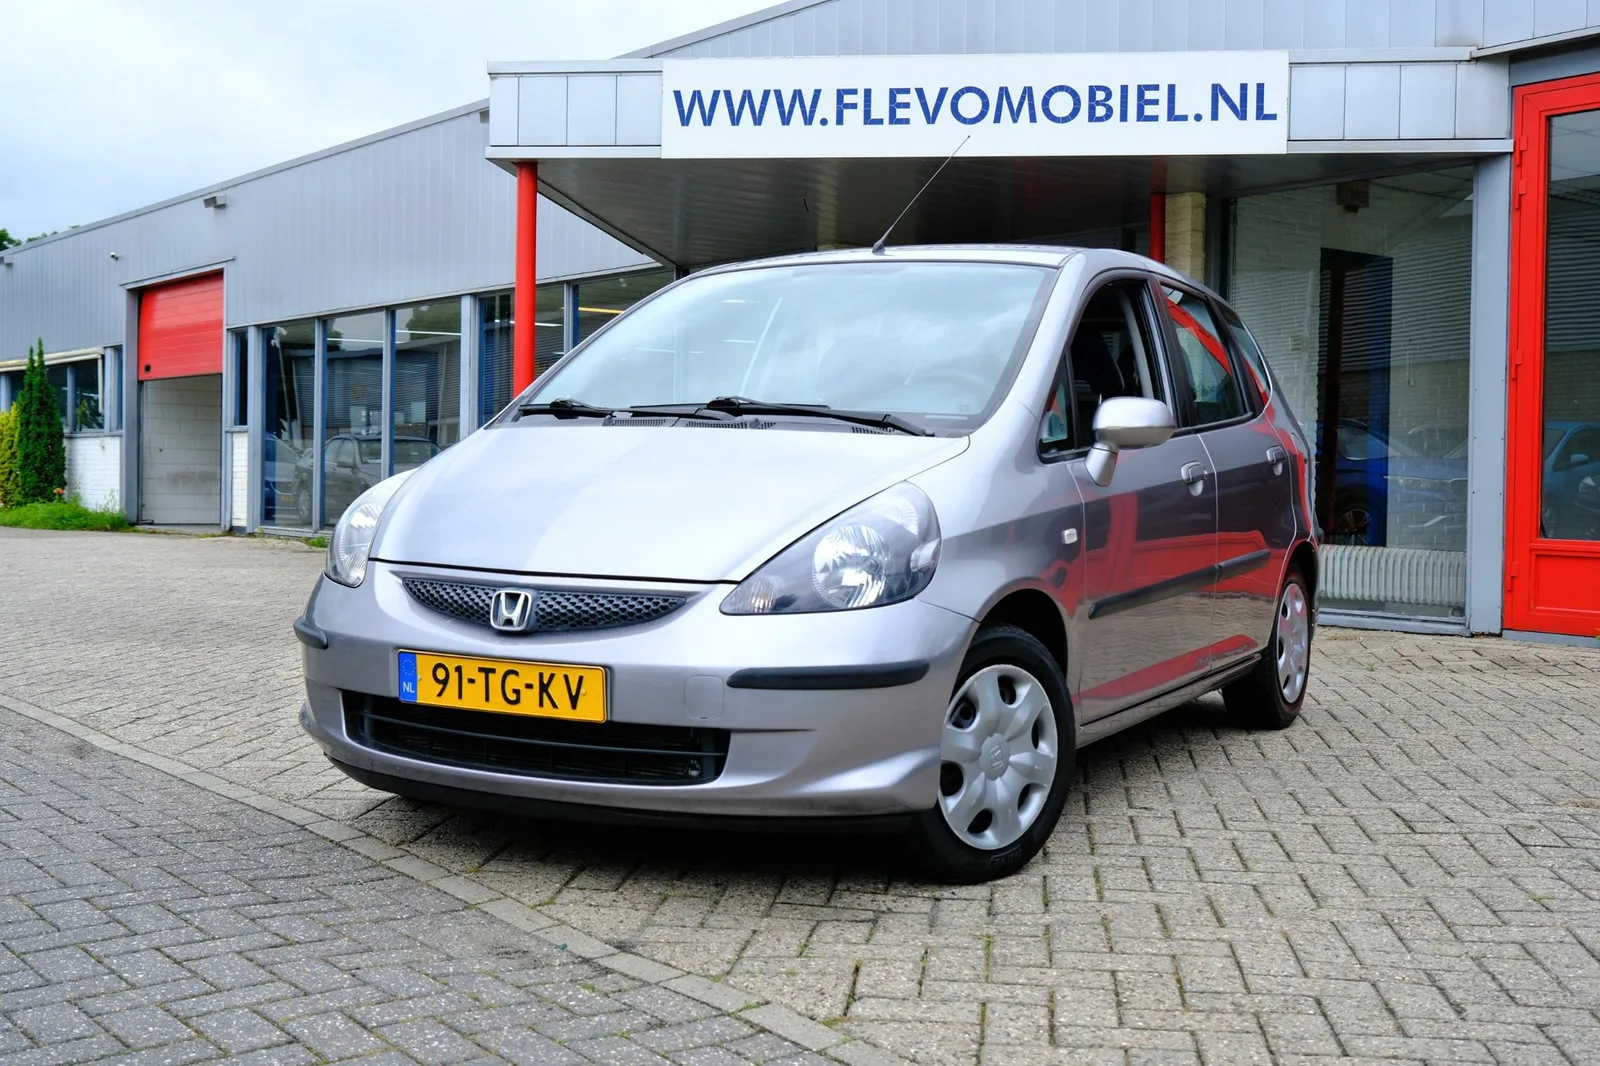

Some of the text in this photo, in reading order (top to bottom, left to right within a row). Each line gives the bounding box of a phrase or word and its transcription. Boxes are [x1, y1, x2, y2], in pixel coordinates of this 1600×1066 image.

[673, 82, 1278, 127] WWW.FLEVOMOBIEL.NL
[402, 681, 416, 694] NL
[431, 662, 584, 710] 91-TG-KV
